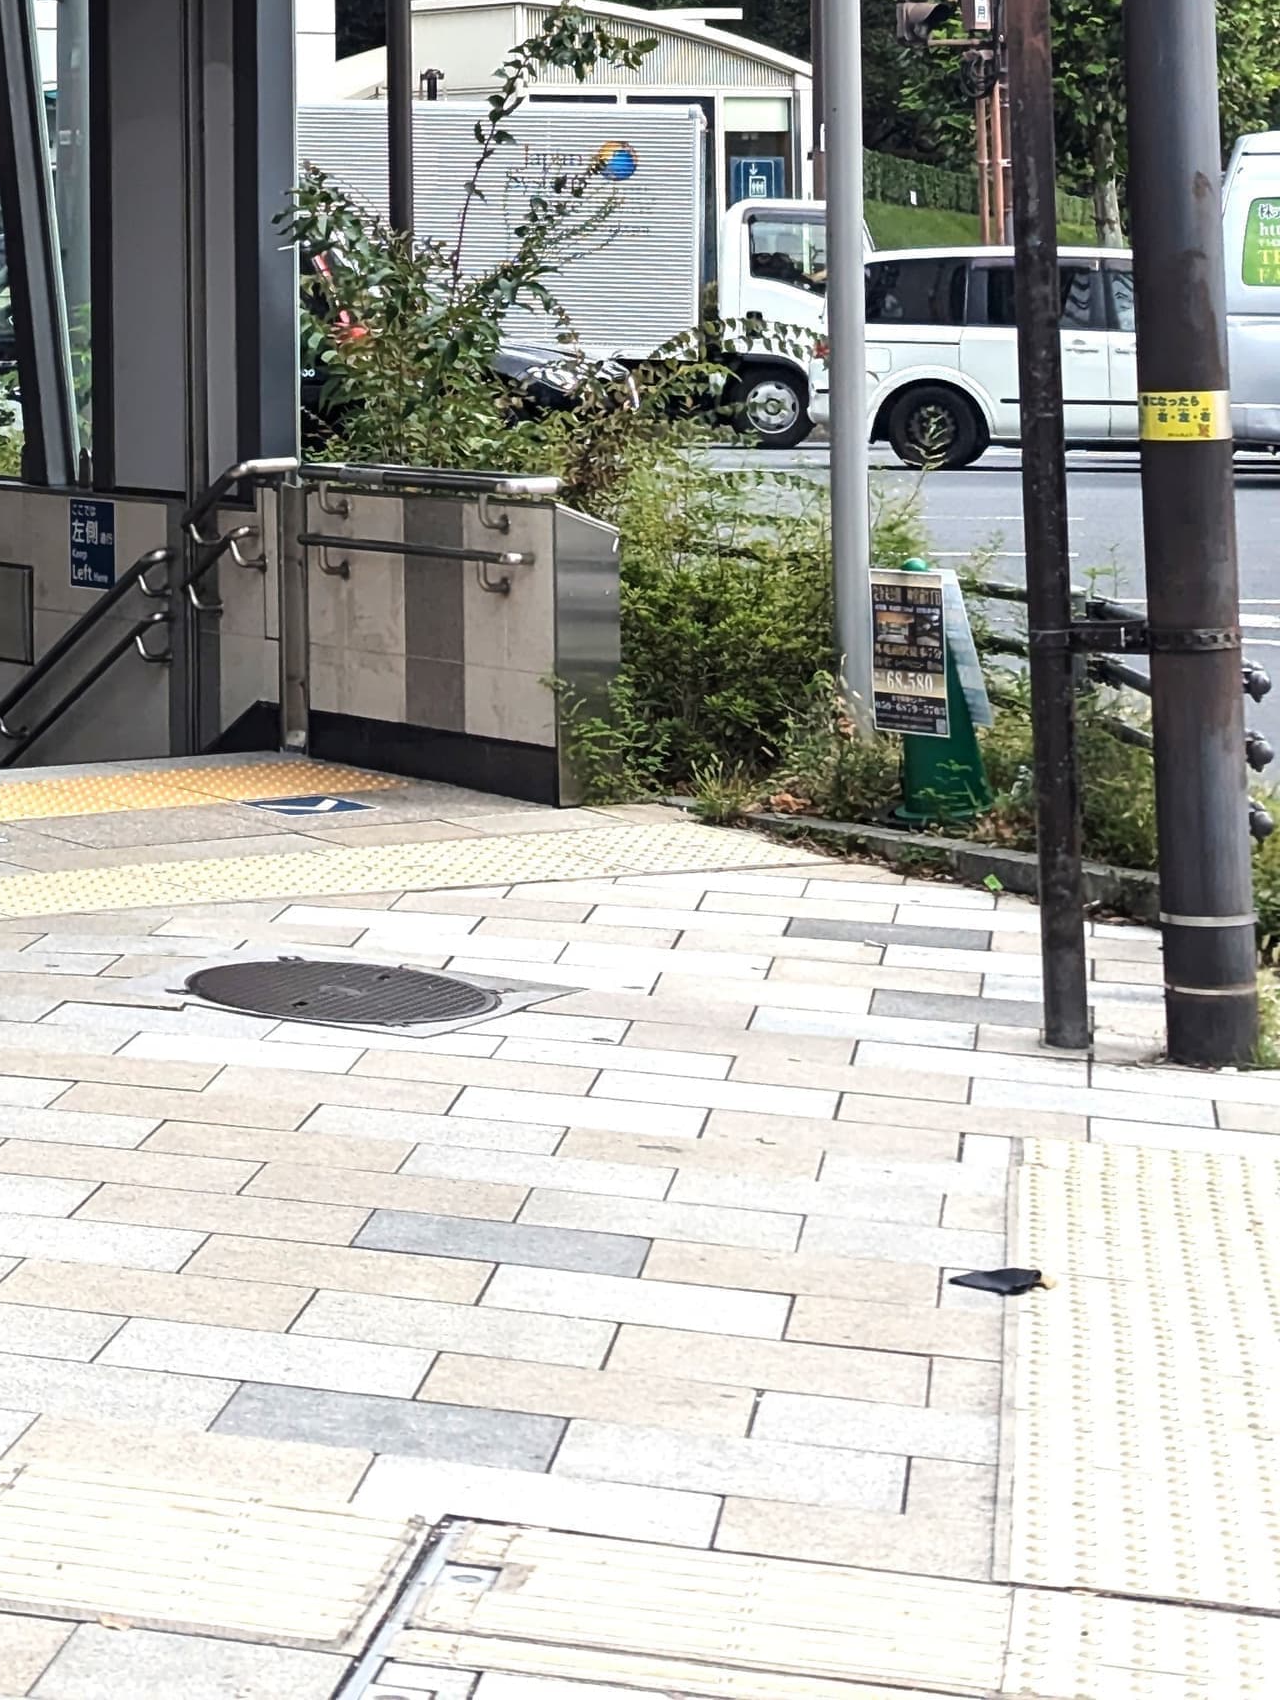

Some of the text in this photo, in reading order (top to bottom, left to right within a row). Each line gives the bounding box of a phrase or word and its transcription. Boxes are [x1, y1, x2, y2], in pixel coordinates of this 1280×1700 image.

[72, 504, 96, 517] ここでは
[72, 563, 93, 581] Left
